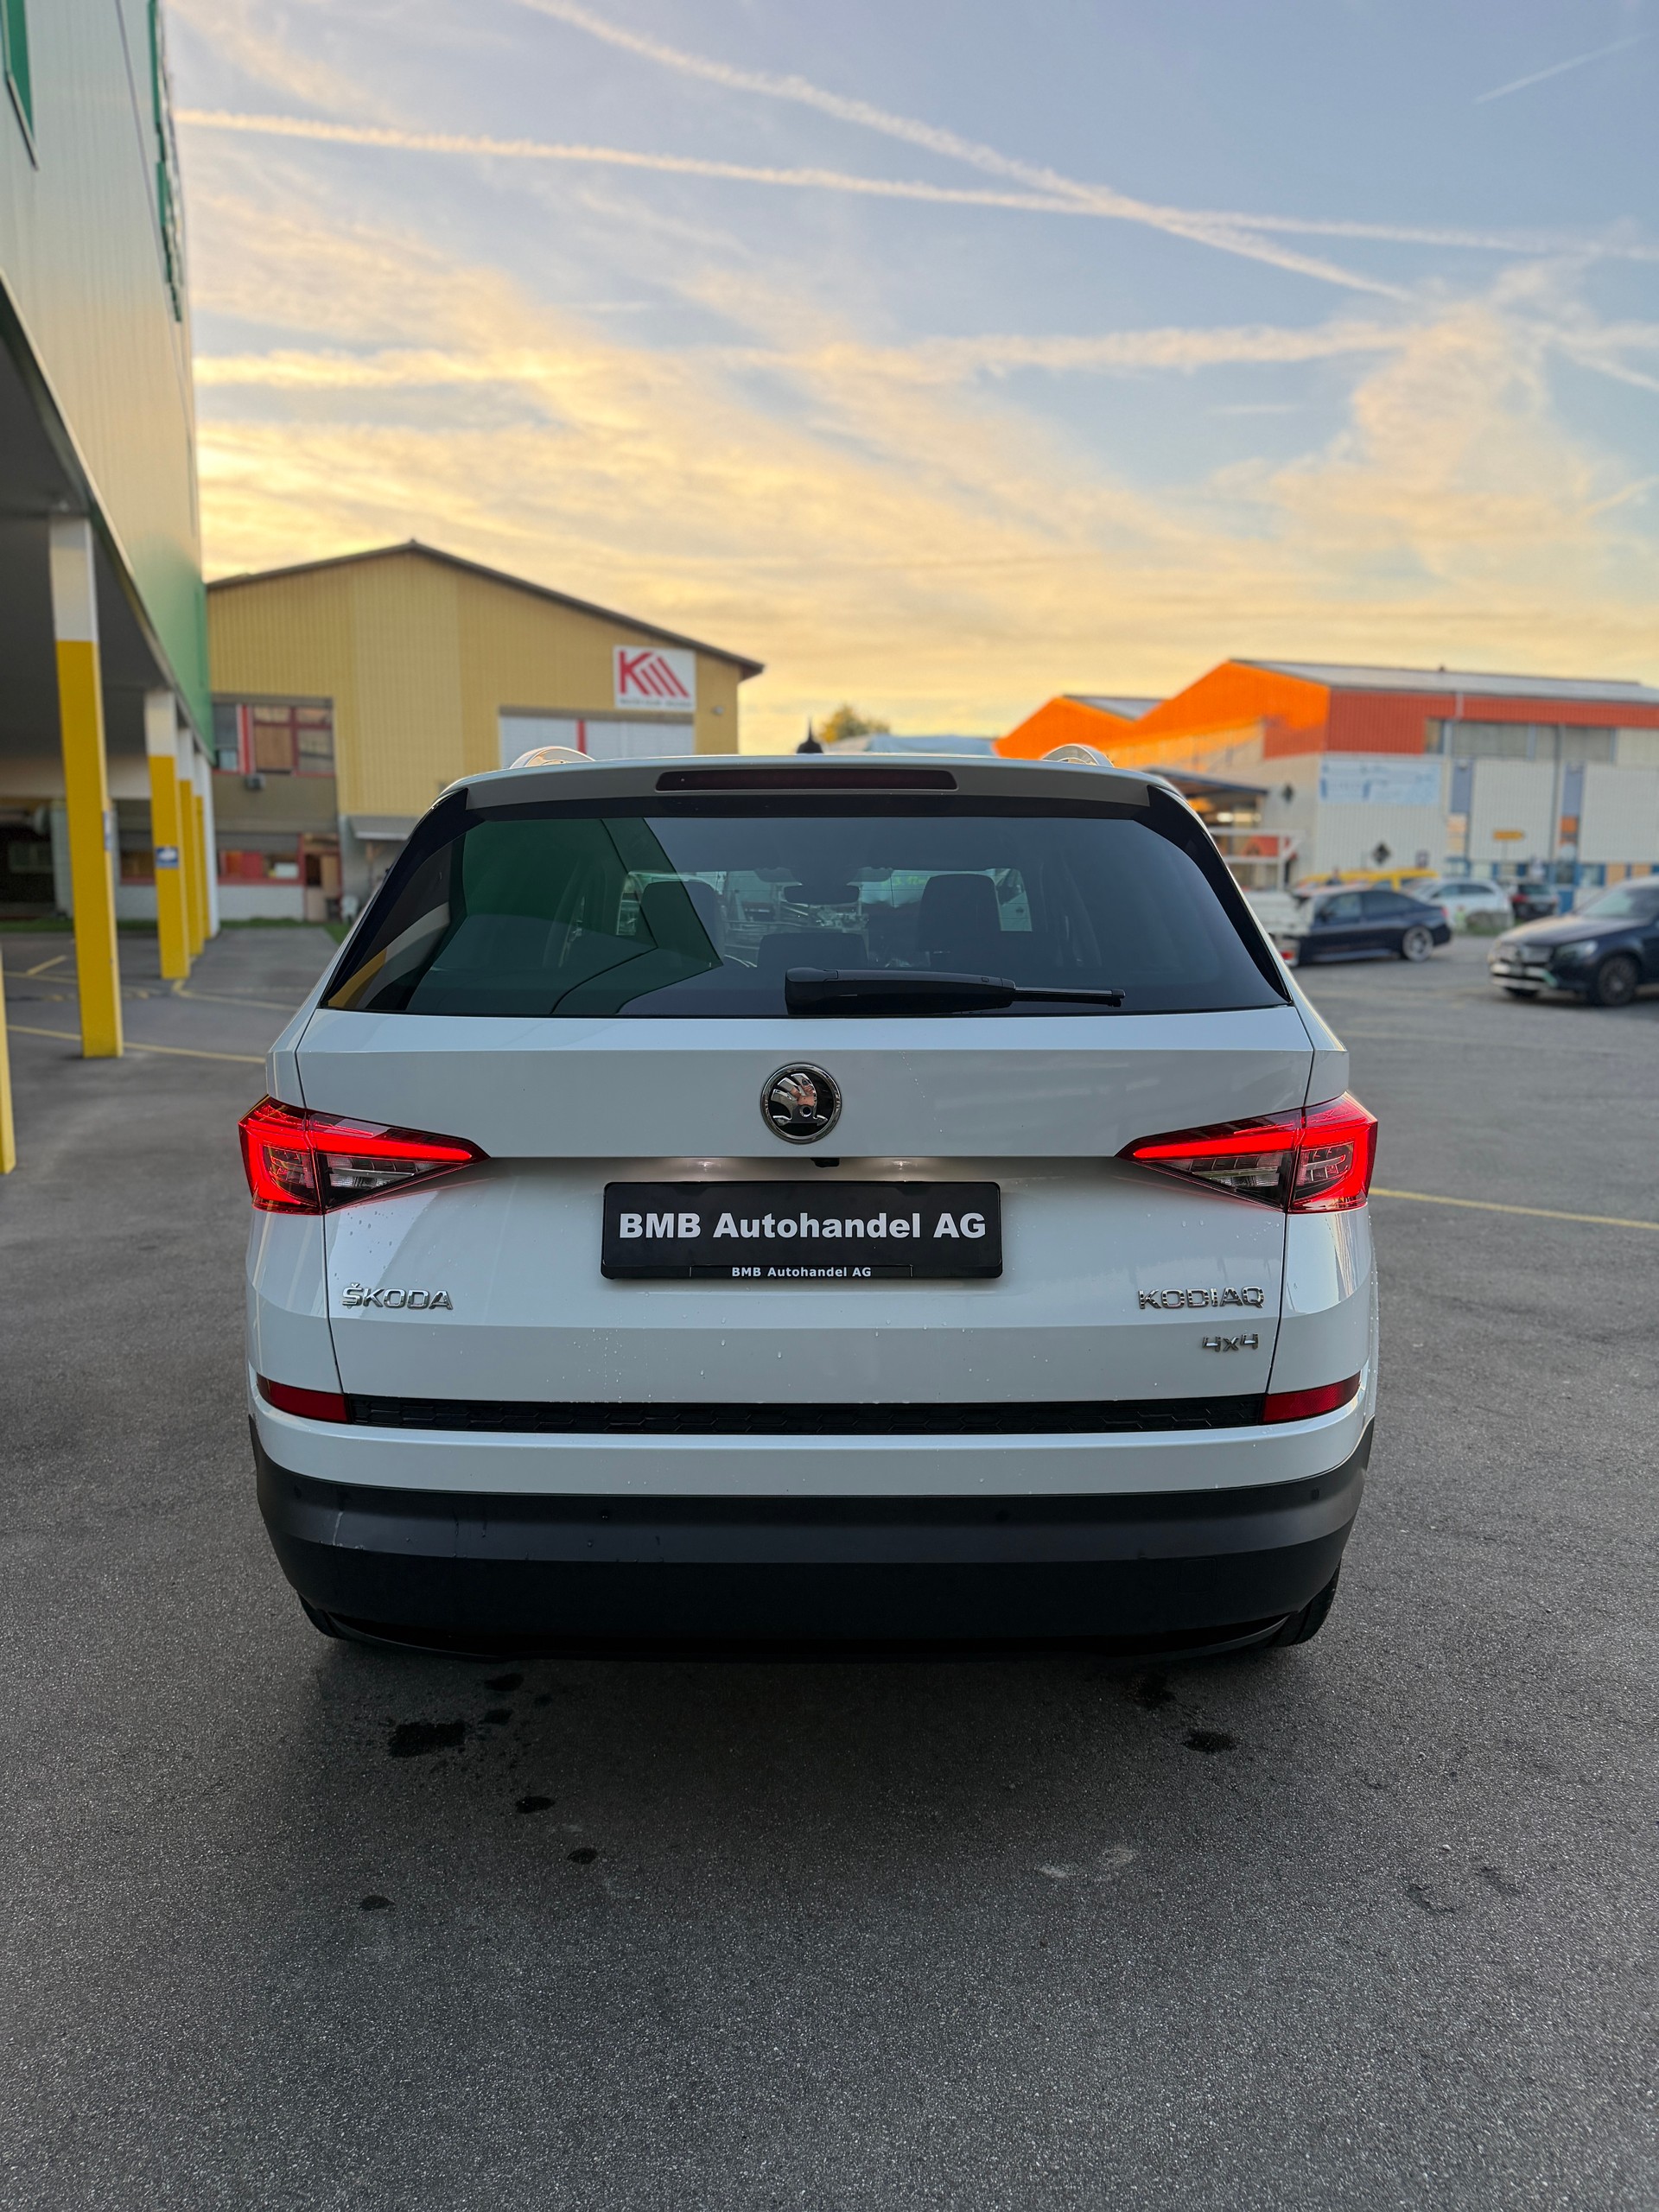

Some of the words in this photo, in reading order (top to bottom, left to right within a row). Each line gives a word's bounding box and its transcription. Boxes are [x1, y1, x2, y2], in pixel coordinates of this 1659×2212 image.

[619, 1212, 702, 1239] BMB
[713, 1212, 921, 1239] Autohandel
[932, 1212, 986, 1239] AG
[731, 1267, 762, 1277] BMB
[766, 1267, 848, 1277] Autohandel
[852, 1267, 872, 1277] AG
[342, 1283, 454, 1310] ŠKODA
[1138, 1286, 1265, 1309] KODIAQ
[1202, 1333, 1259, 1352] 4x4
